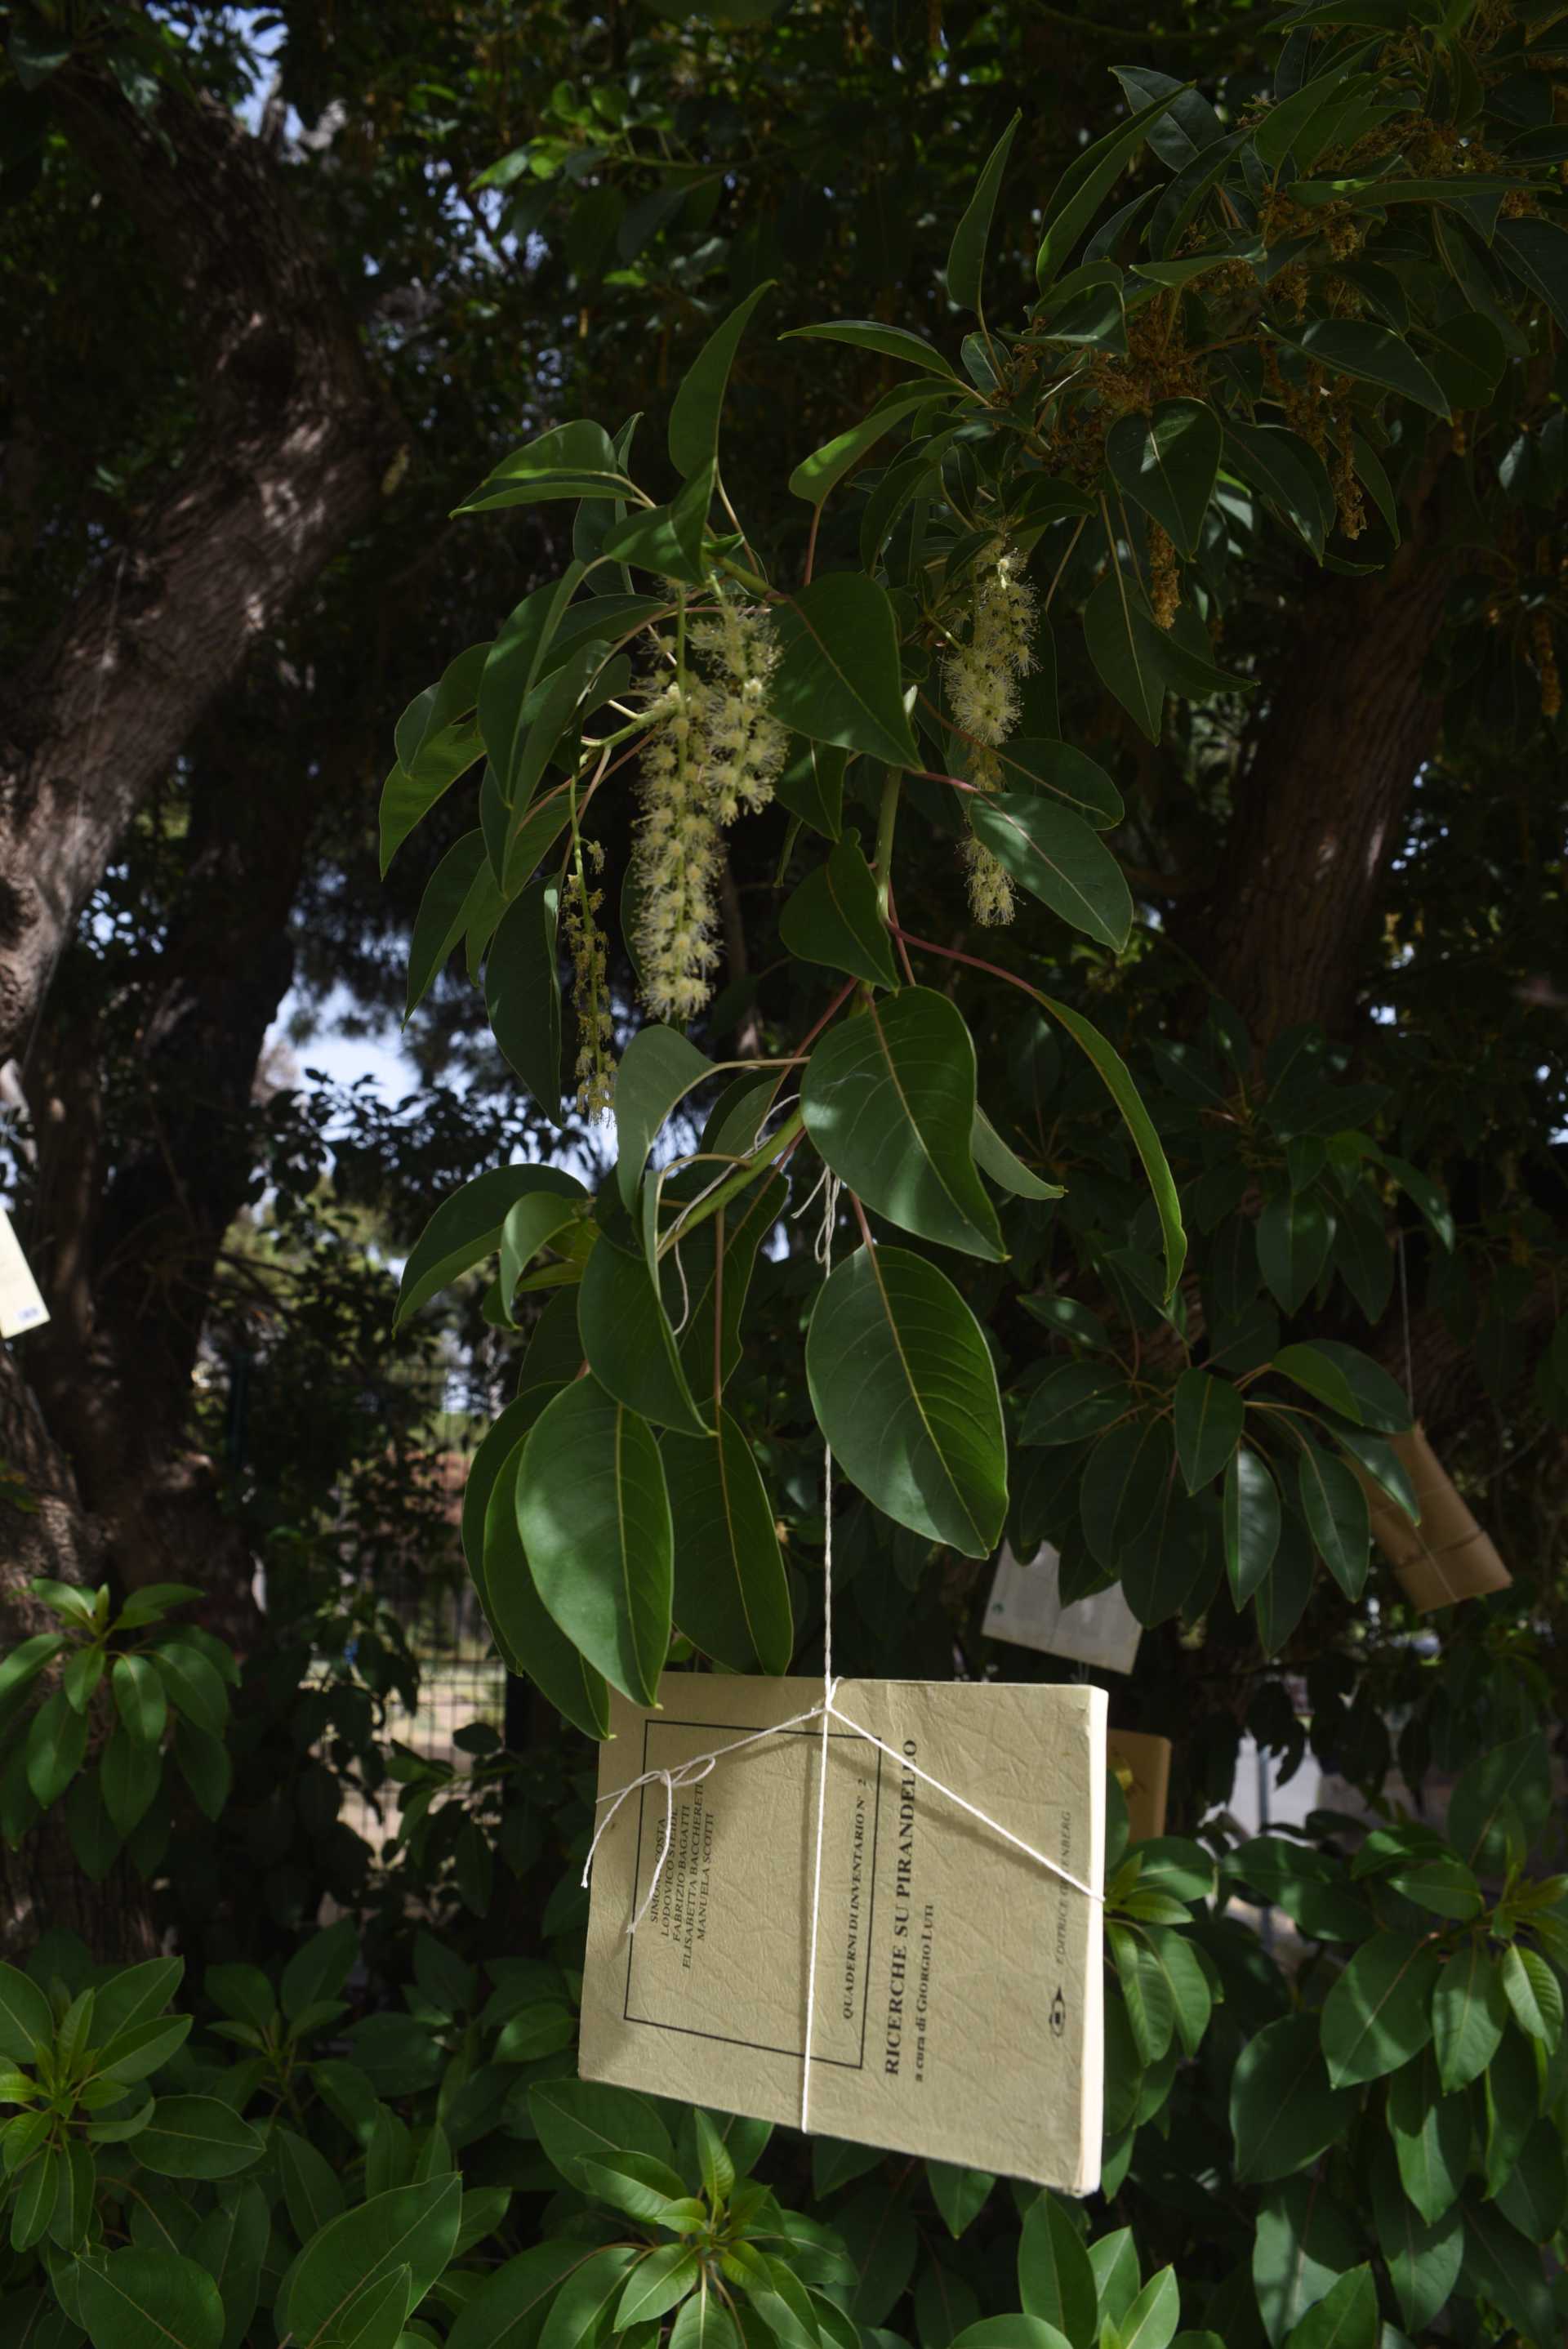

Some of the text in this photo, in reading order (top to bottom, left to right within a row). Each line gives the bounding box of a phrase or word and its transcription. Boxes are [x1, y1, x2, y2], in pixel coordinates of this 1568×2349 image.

[858, 1778, 866, 1787] 2
[654, 1818, 666, 1863] COSTA
[850, 1813, 865, 1910] INVENTARIO
[662, 1860, 675, 1937] LODOVICO
[672, 1805, 690, 1942] FABRIZIO BAGATTI
[682, 1783, 704, 1968] ELISABETTA BACCHERETI
[697, 1813, 715, 1941] MANUELA SCOTTI
[849, 1913, 859, 1931] DI
[894, 1905, 910, 1938] SU
[843, 1933, 858, 2020] QUADERNI
[884, 1945, 906, 2075] RICERCHE
[915, 2017, 927, 2032] di
[915, 2036, 925, 2070] cura
[915, 2073, 924, 2083] a
